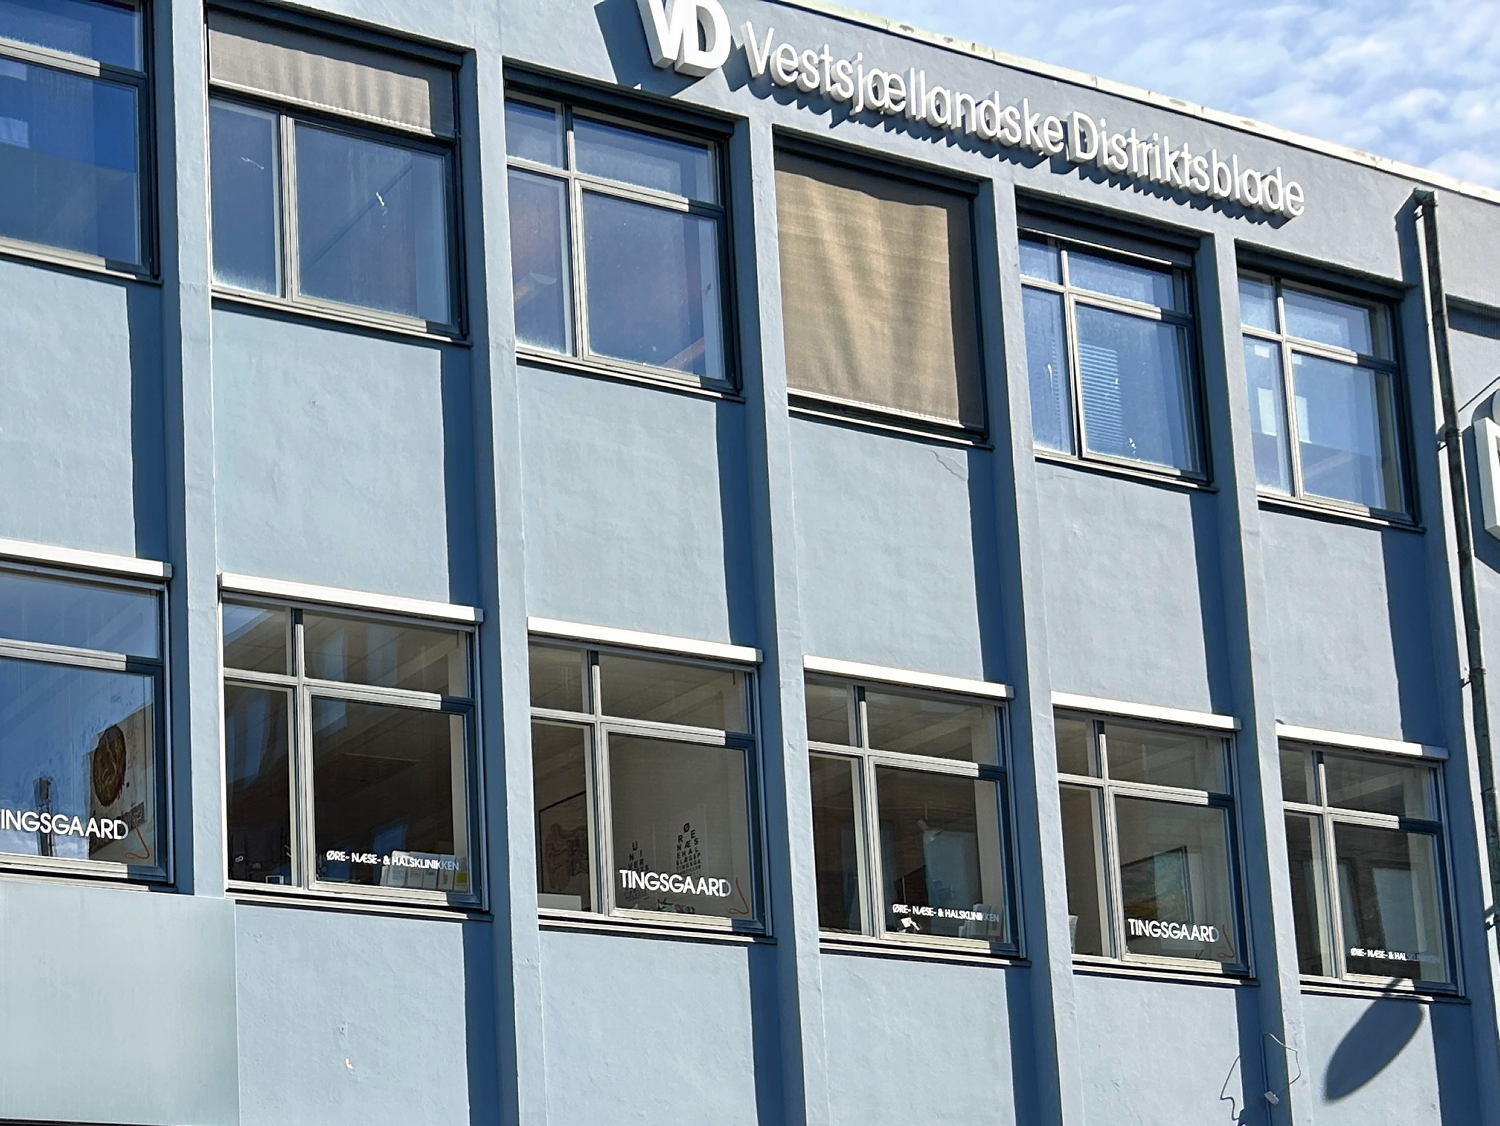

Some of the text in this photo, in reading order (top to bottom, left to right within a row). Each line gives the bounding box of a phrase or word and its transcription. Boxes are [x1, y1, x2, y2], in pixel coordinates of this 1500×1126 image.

[638, 0, 1304, 217] VD Vestsjællandske Distriktsblade
[326, 850, 349, 861] ØRE-
[351, 853, 381, 865] NÆSE-
[383, 855, 390, 865] &
[619, 869, 732, 897] TINGSGAARD
[912, 905, 936, 917] NÆSE-
[1127, 918, 1219, 942] TINGSGAARD
